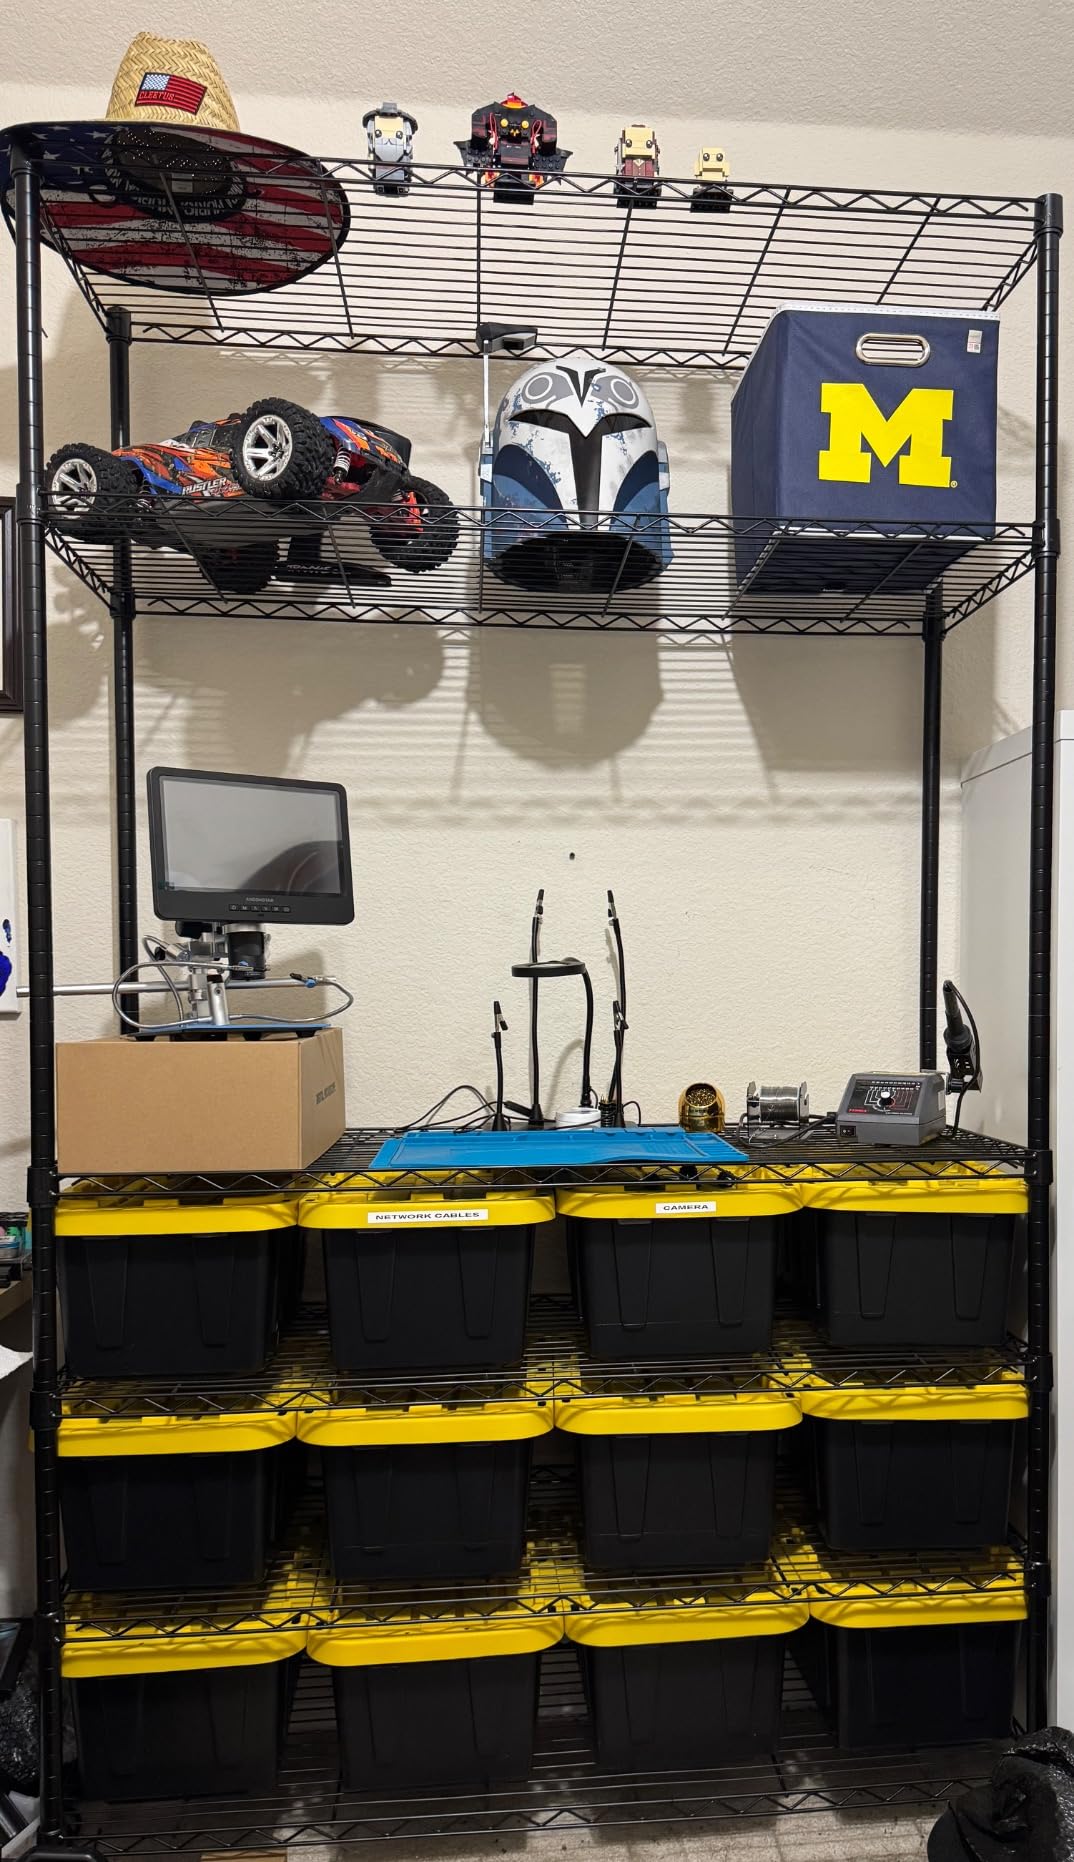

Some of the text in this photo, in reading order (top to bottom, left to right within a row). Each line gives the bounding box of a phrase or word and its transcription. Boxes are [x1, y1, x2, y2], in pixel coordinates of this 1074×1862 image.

[139, 90, 175, 101] CLEETUS
[818, 382, 954, 488] M
[182, 477, 227, 495] RUSTLER
